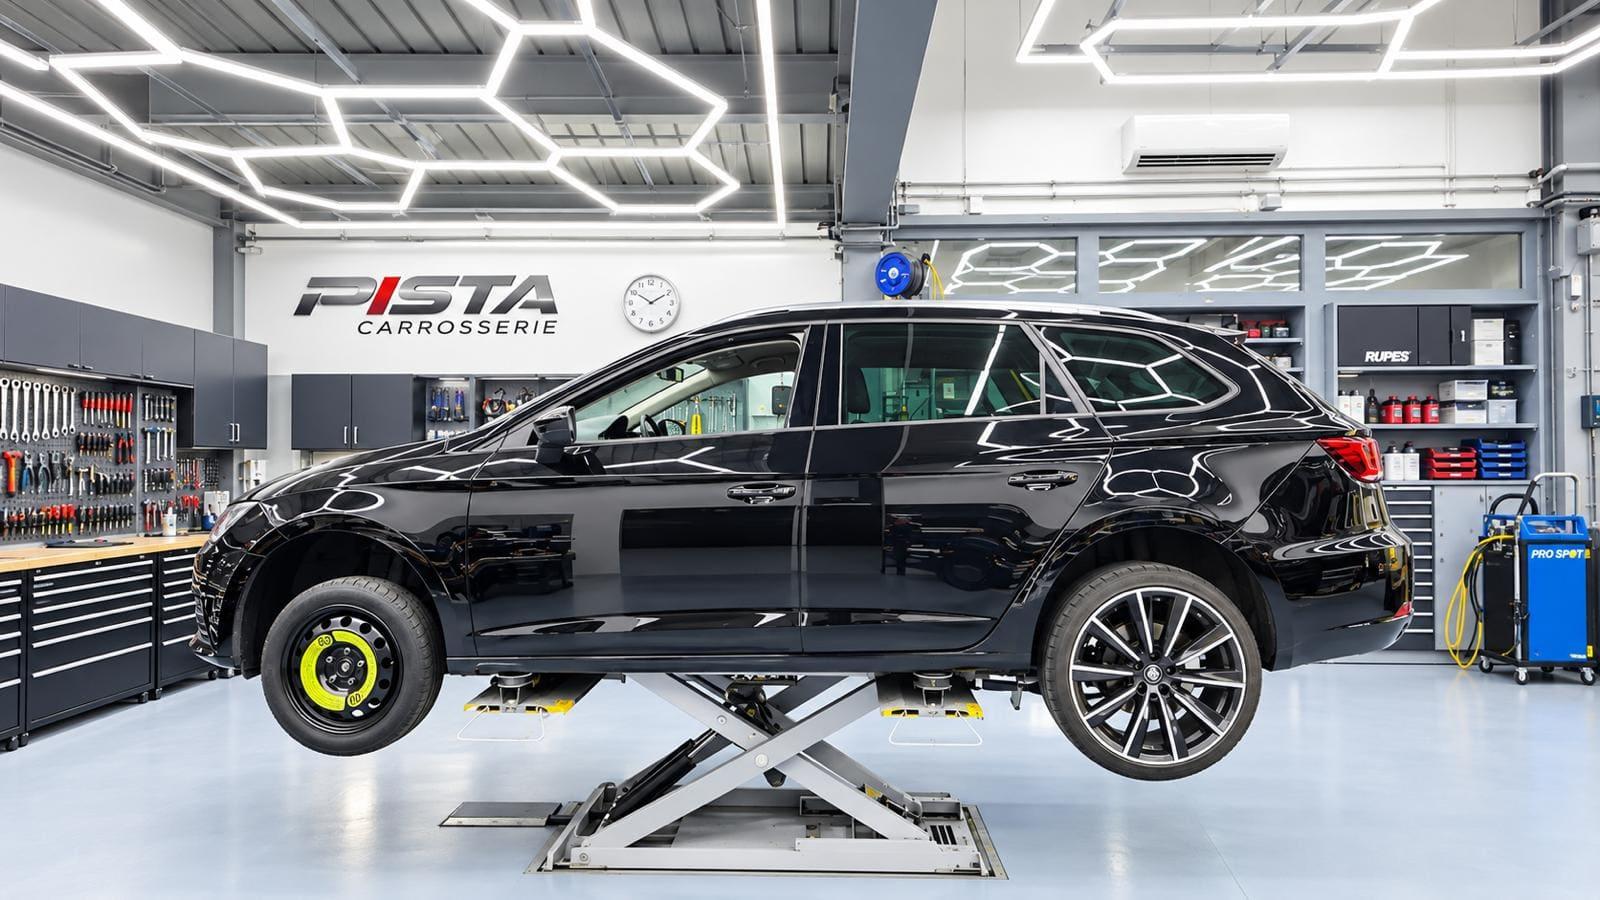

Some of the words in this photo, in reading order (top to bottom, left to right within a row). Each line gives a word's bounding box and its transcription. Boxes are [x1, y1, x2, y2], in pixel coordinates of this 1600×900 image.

[293, 275, 558, 316] PISTA
[357, 320, 558, 335] CARROSSERIE
[1364, 351, 1410, 362] RUPES
[1531, 549, 1554, 559] PRO
